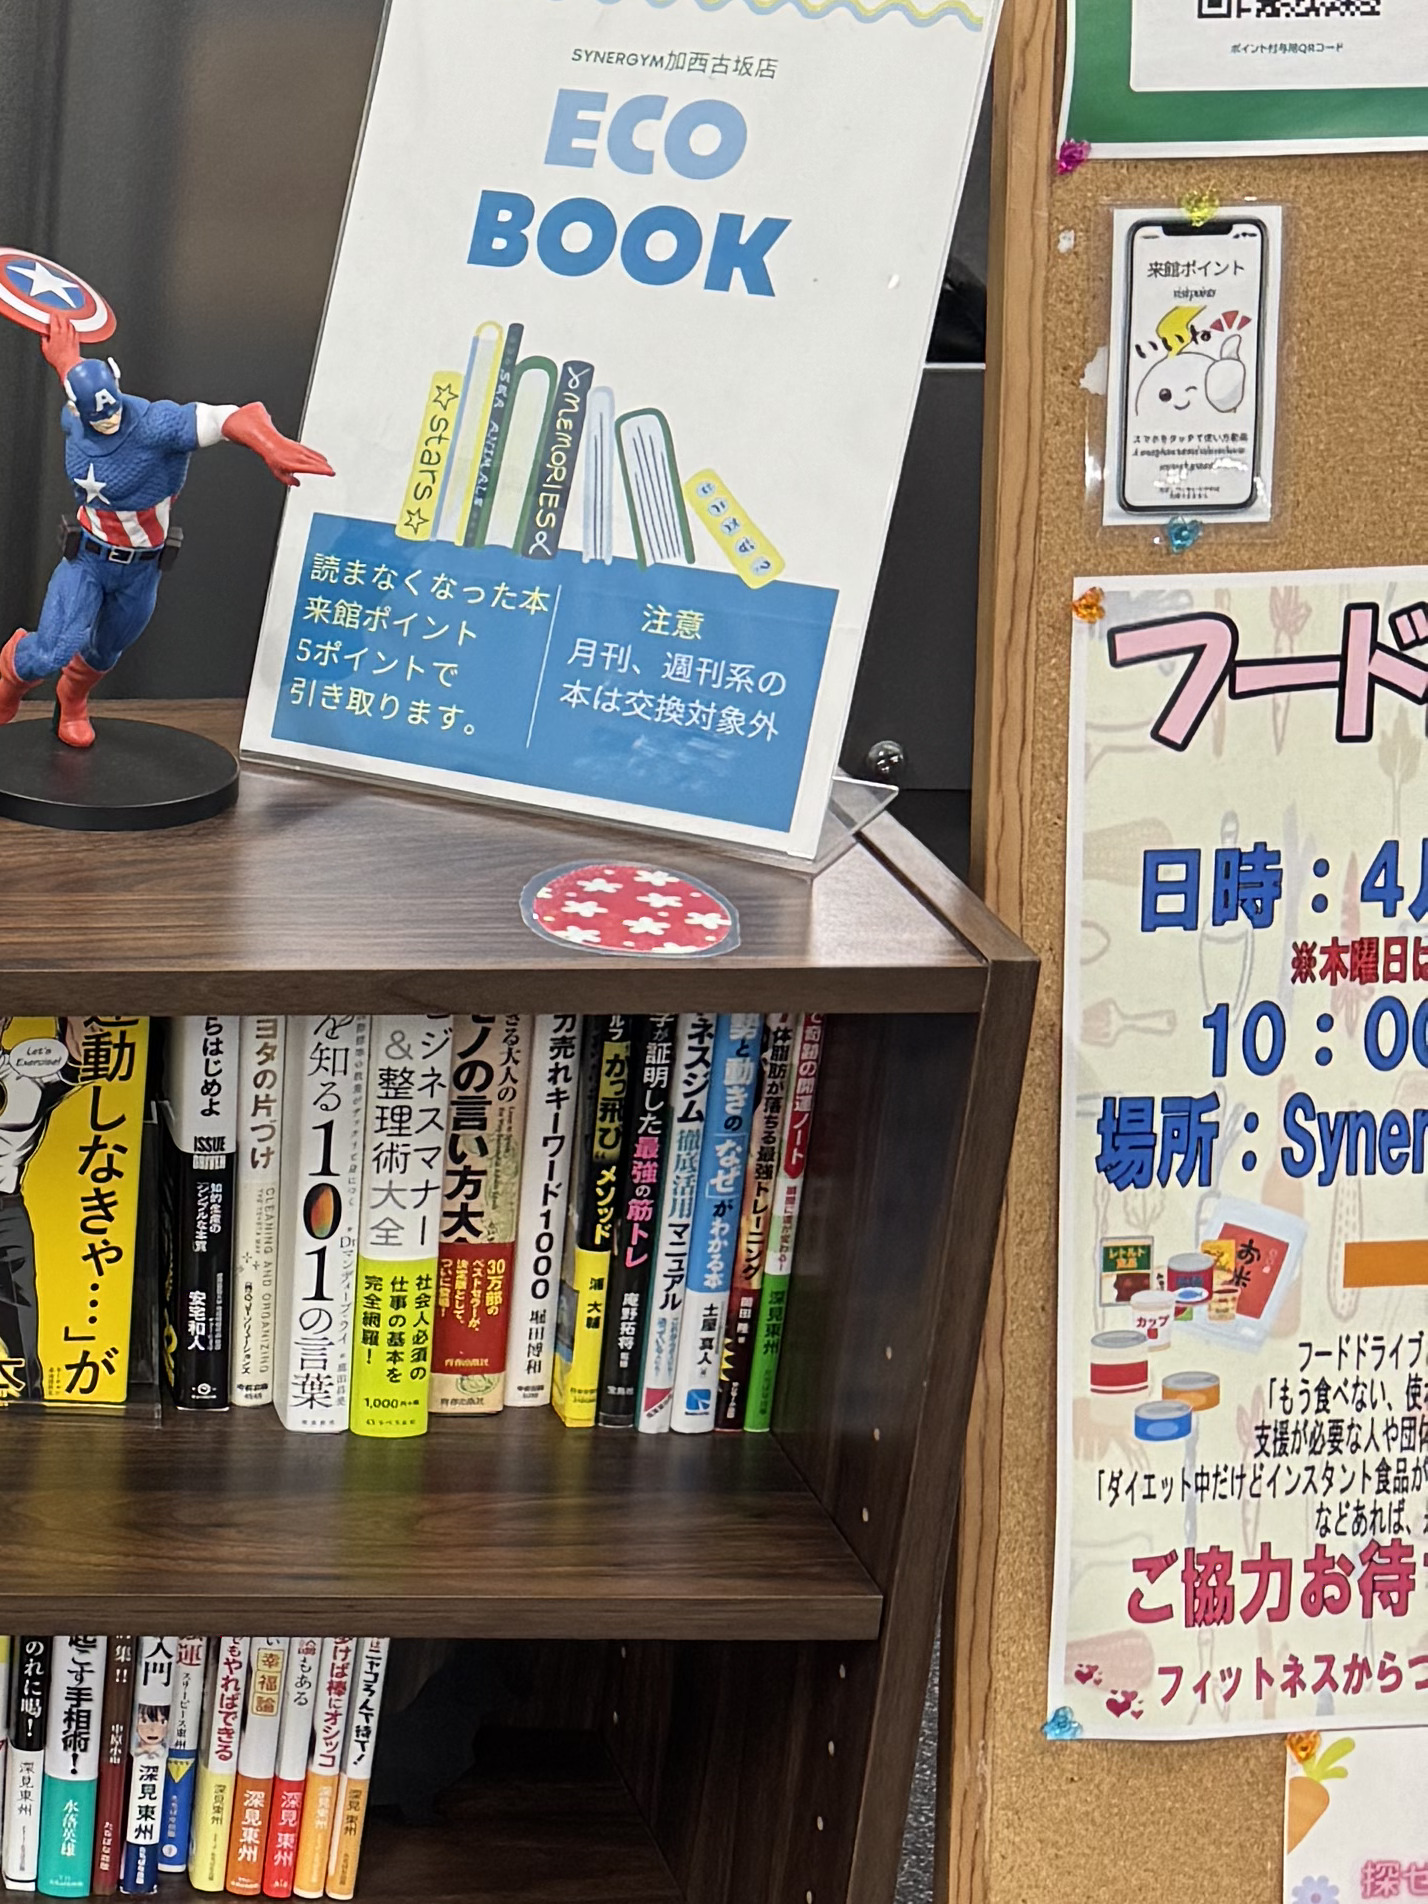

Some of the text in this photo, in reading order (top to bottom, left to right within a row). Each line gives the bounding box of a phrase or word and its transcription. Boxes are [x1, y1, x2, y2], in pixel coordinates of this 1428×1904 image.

[543, 87, 748, 180] ECO
[467, 189, 793, 297] BOOK
[1148, 260, 1245, 278] 来館ポイント
[414, 416, 449, 502] stars
[535, 393, 581, 528] MEMORIES
[311, 552, 550, 615] 読まなくなった本
[303, 597, 478, 647] 来館ポイント
[641, 604, 705, 641] 注意
[296, 640, 458, 688] 5ポイントで
[567, 638, 787, 696] 月刊、週刊系の
[289, 678, 476, 737] 引き取ります。
[560, 680, 779, 743] 本は交換対象外
[194, 1136, 226, 1152] ISSUE
[369, 1030, 415, 1248] &整理術大全
[412, 1015, 454, 1246] ジネスマナー
[441, 1015, 495, 1243] ノの言い方大
[594, 1165, 617, 1245] メソッド
[660, 1224, 690, 1311] マニュアル
[188, 1290, 205, 1351] 安宅和人
[386, 1275, 409, 1383] 仕事の基本を
[410, 1274, 433, 1381] 社会人必須の
[1136, 1315, 1170, 1328] カップ
[18, 1761, 35, 1816] 深見東州
[134, 1765, 160, 1840] 深見東州
[238, 1790, 265, 1862] 深見東州
[273, 1791, 301, 1867] 深見東州
